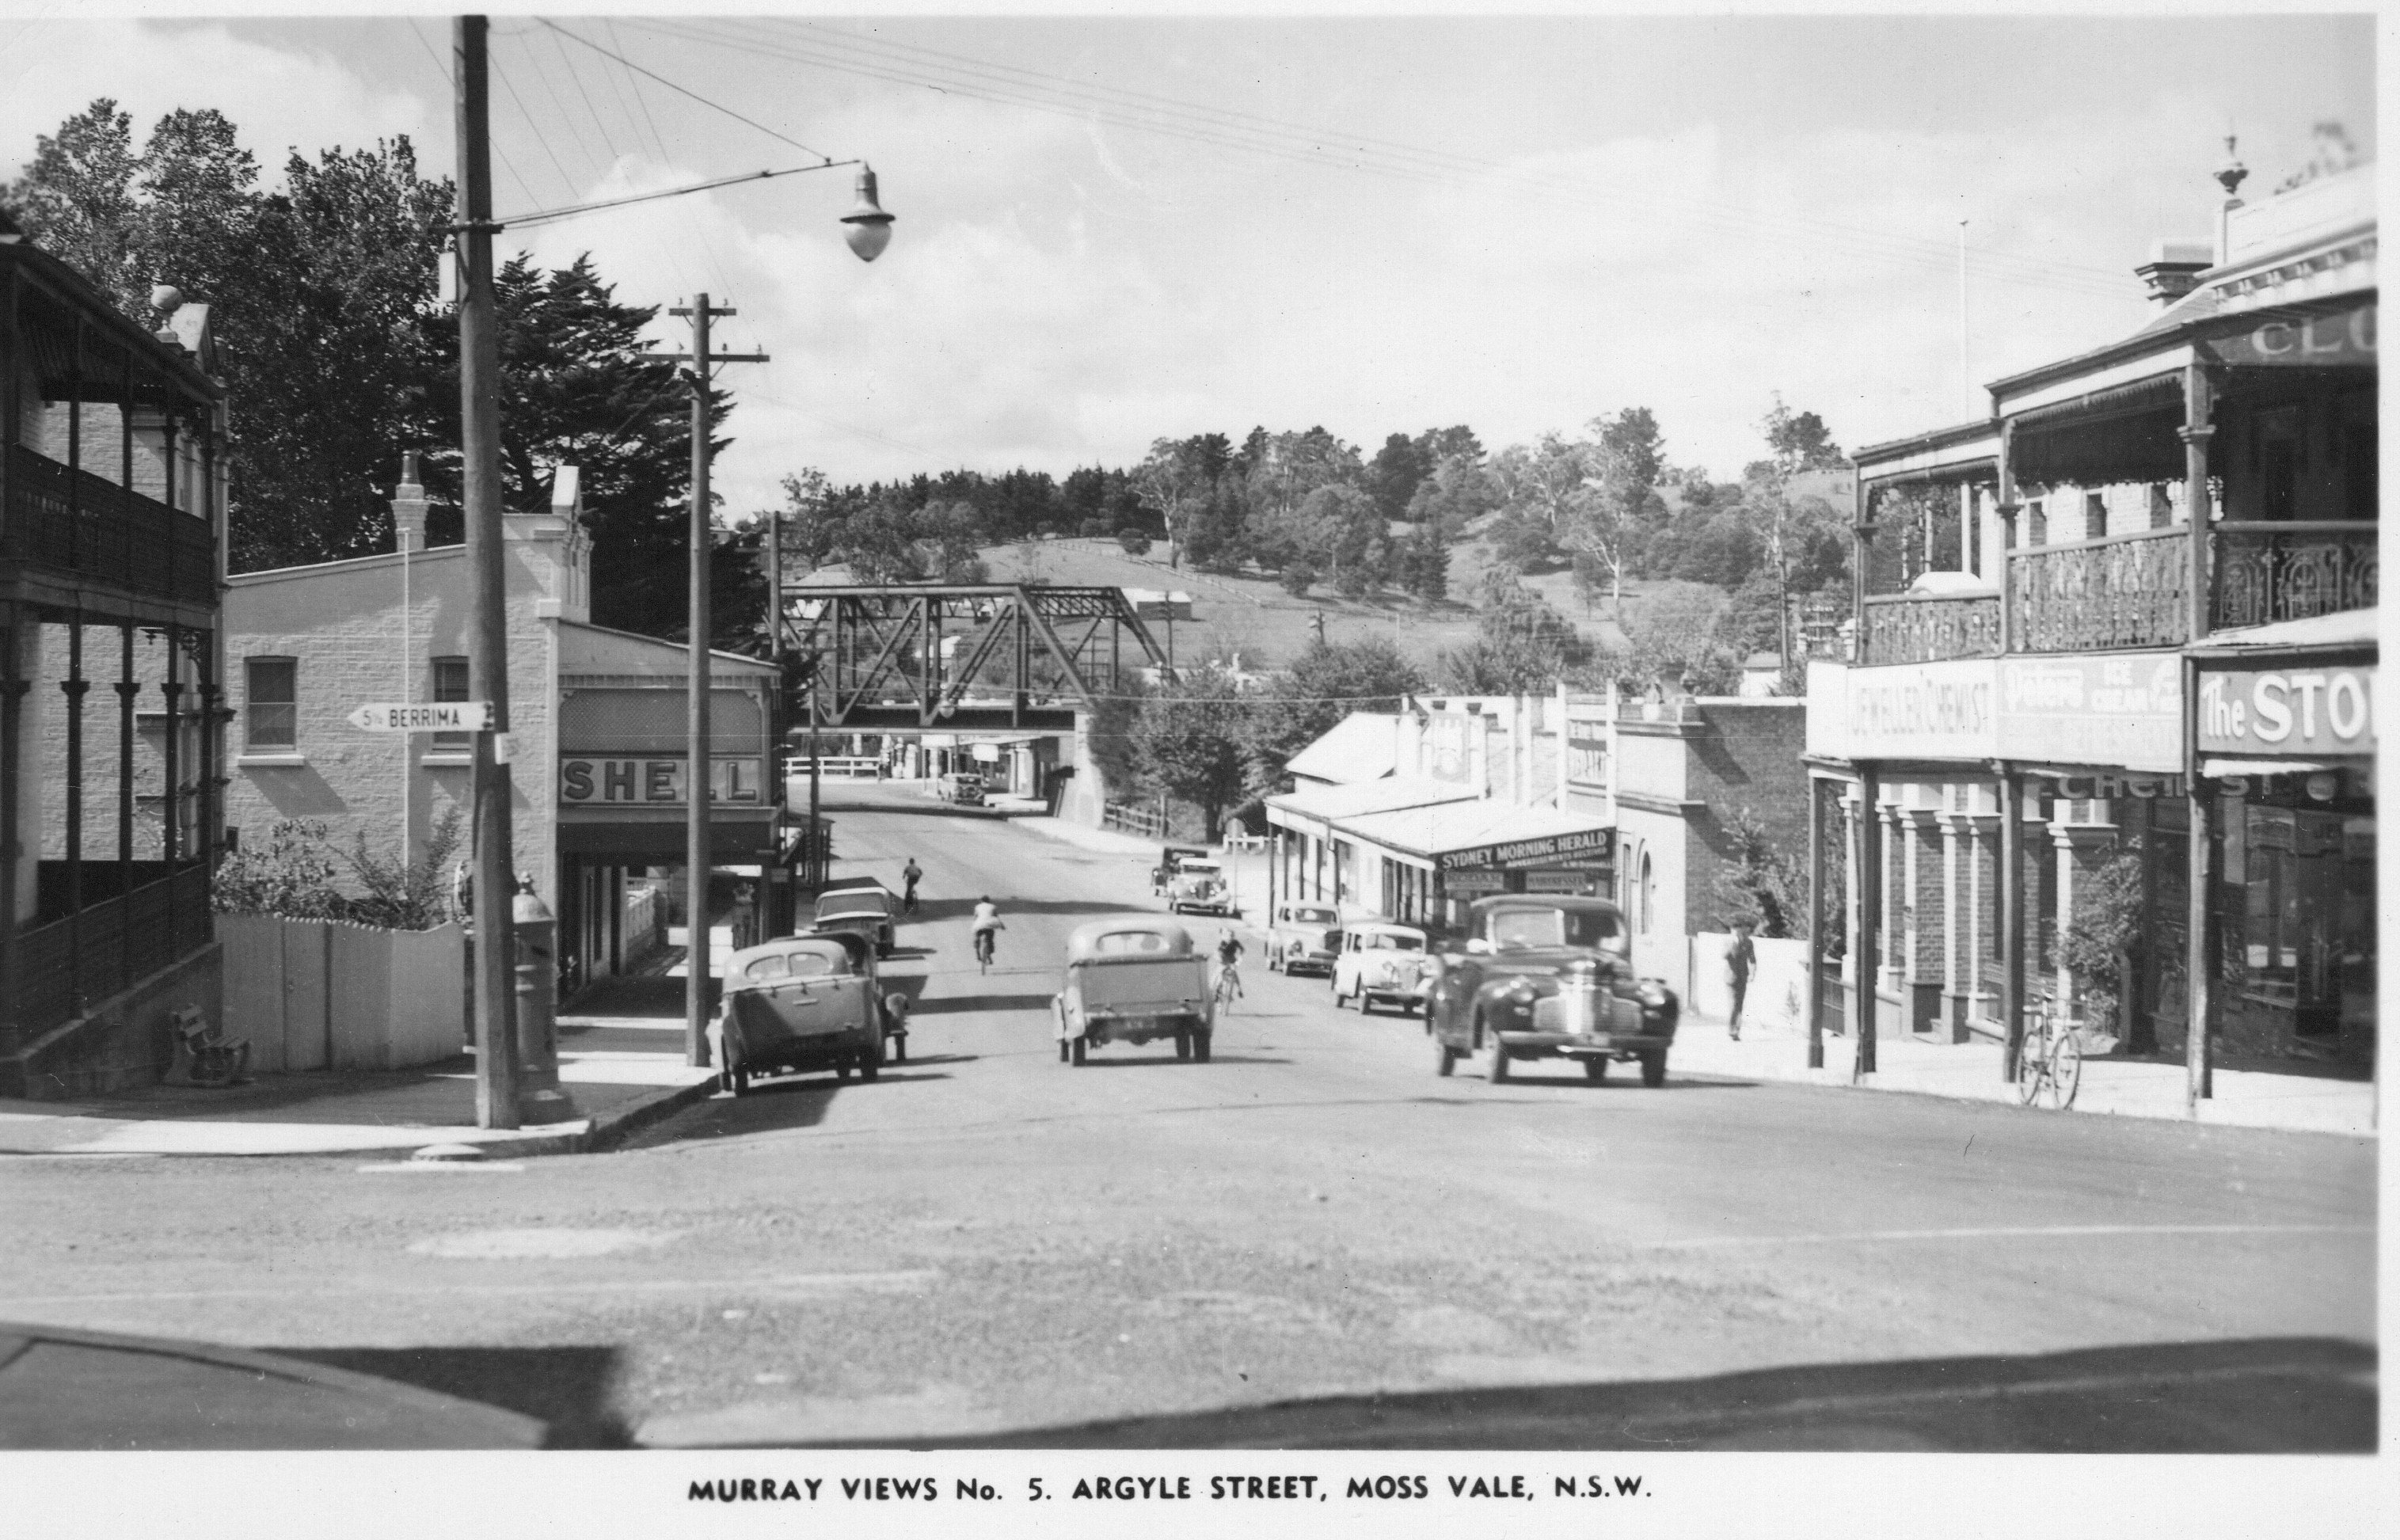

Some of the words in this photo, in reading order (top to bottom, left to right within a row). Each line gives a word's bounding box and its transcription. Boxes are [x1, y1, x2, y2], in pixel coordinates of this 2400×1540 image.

[389, 709, 461, 728] BERRIMA
[2200, 675, 2246, 738] The
[1442, 848, 1493, 869] SYDNEY
[1497, 838, 1555, 861] MORNING
[1557, 831, 1607, 852] HERALD
